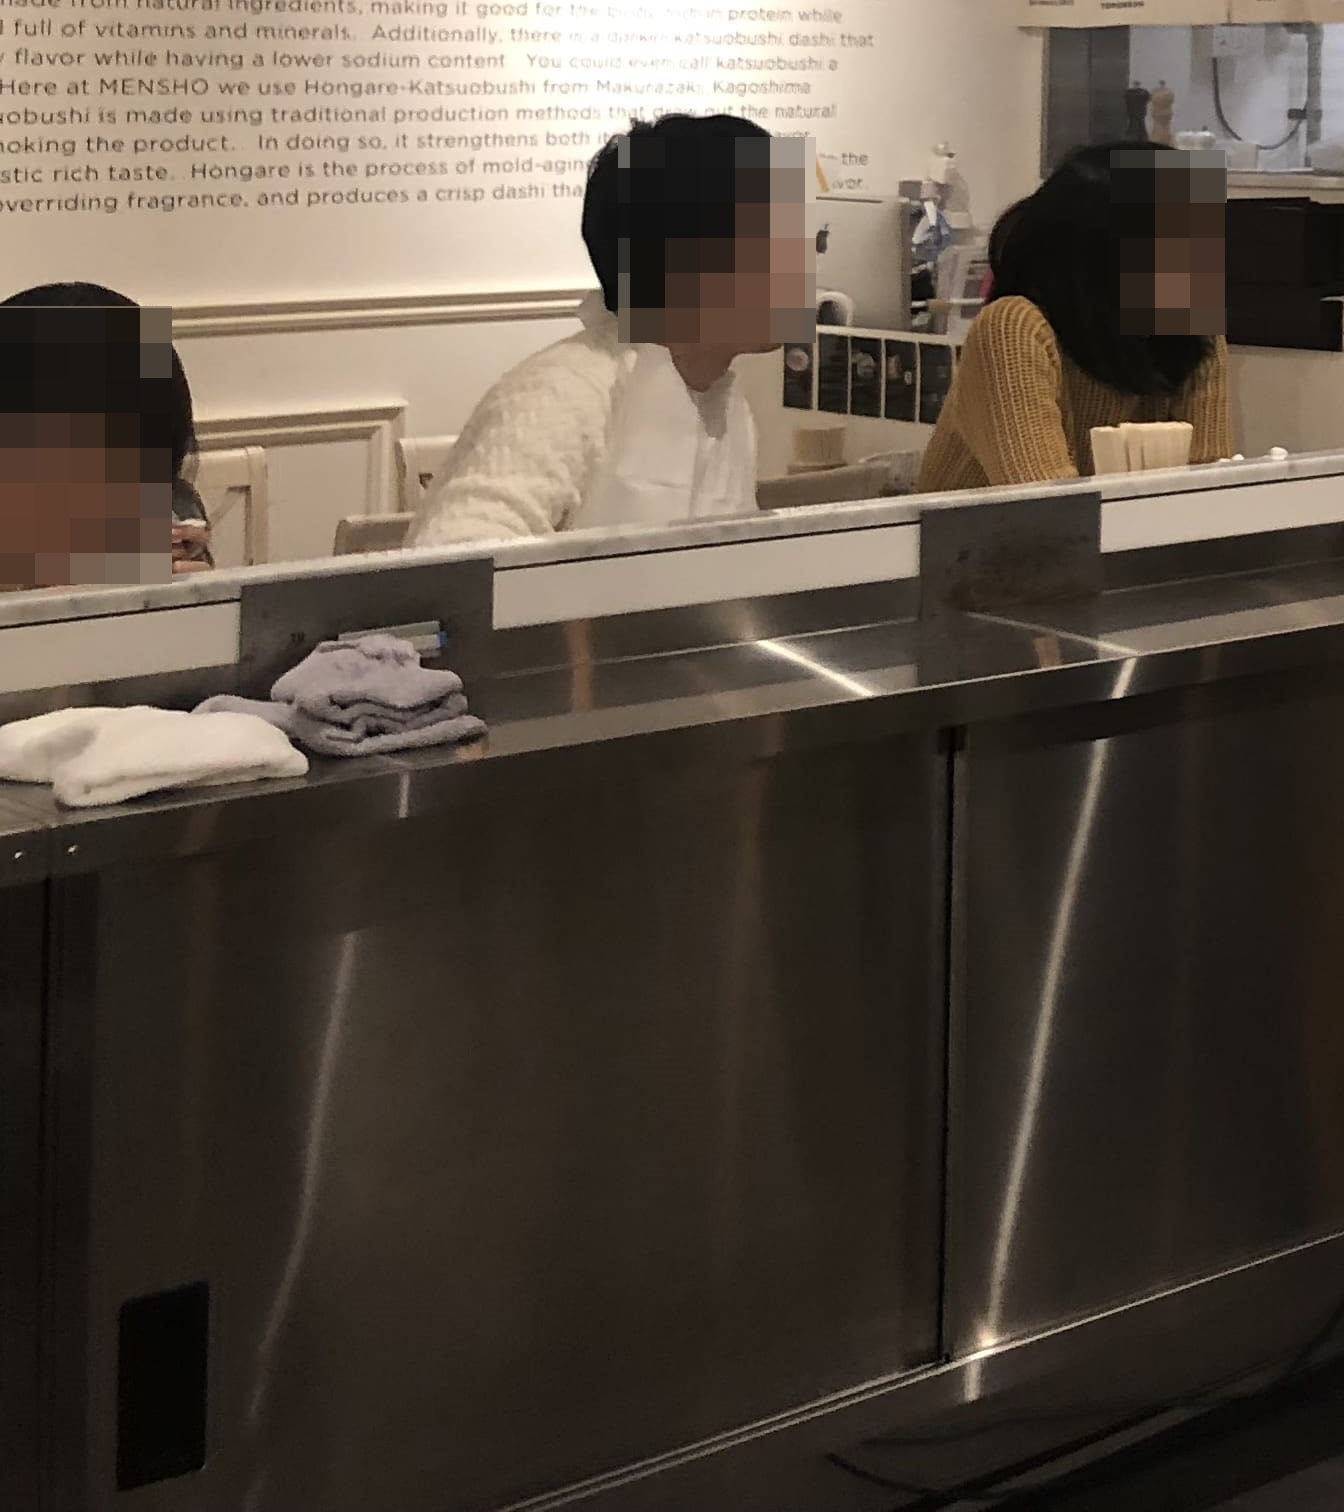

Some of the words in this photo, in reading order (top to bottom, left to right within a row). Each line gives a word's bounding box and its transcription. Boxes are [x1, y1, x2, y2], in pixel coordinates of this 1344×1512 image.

[456, 1, 467, 15] it
[476, 2, 528, 19] good
[728, 7, 793, 24] protein
[798, 9, 842, 23] while
[14, 18, 51, 37] full
[61, 19, 86, 38] of
[96, 21, 196, 39] vitamins
[204, 22, 247, 39] and
[511, 28, 562, 42] there
[672, 32, 784, 46] katsuobushi
[789, 32, 834, 46] dashi
[840, 33, 874, 48] that
[15, 48, 85, 66] flavor
[94, 50, 157, 66] while
[166, 50, 243, 70] having
[252, 54, 264, 67] a
[272, 51, 333, 68] lower
[342, 52, 420, 68] sodium
[526, 54, 562, 68] You
[716, 56, 822, 71] katsuobushi
[828, 59, 839, 71] a
[0, 79, 57, 96] Here
[67, 80, 89, 96] at
[100, 78, 208, 95] MENSHO
[218, 81, 250, 95] we
[258, 82, 296, 96] use
[543, 80, 588, 94] from
[713, 80, 811, 97] Kagoshima
[98, 107, 116, 124] is
[127, 107, 192, 124] made
[200, 109, 262, 126] using
[271, 106, 386, 123] traditional
[394, 106, 508, 124] production
[516, 105, 600, 120] methods
[609, 106, 644, 120] that
[740, 105, 768, 120] the
[775, 104, 837, 119] natural
[86, 136, 124, 153] the
[259, 134, 278, 150] In
[286, 134, 349, 152] doing
[395, 134, 408, 149] it
[417, 133, 538, 151] strengthens
[546, 131, 590, 146] both
[54, 165, 98, 182] rich
[192, 163, 290, 182] Hongare
[298, 162, 315, 177] is
[323, 161, 357, 177] the
[365, 162, 448, 178] process
[456, 158, 475, 174] of
[483, 157, 588, 175] mold-agin
[841, 152, 868, 166] the
[257, 188, 299, 206] and
[307, 188, 409, 207] produces
[417, 189, 428, 202] a
[435, 187, 485, 203] crisp
[492, 184, 544, 200] dashi
[553, 183, 584, 198] tha
